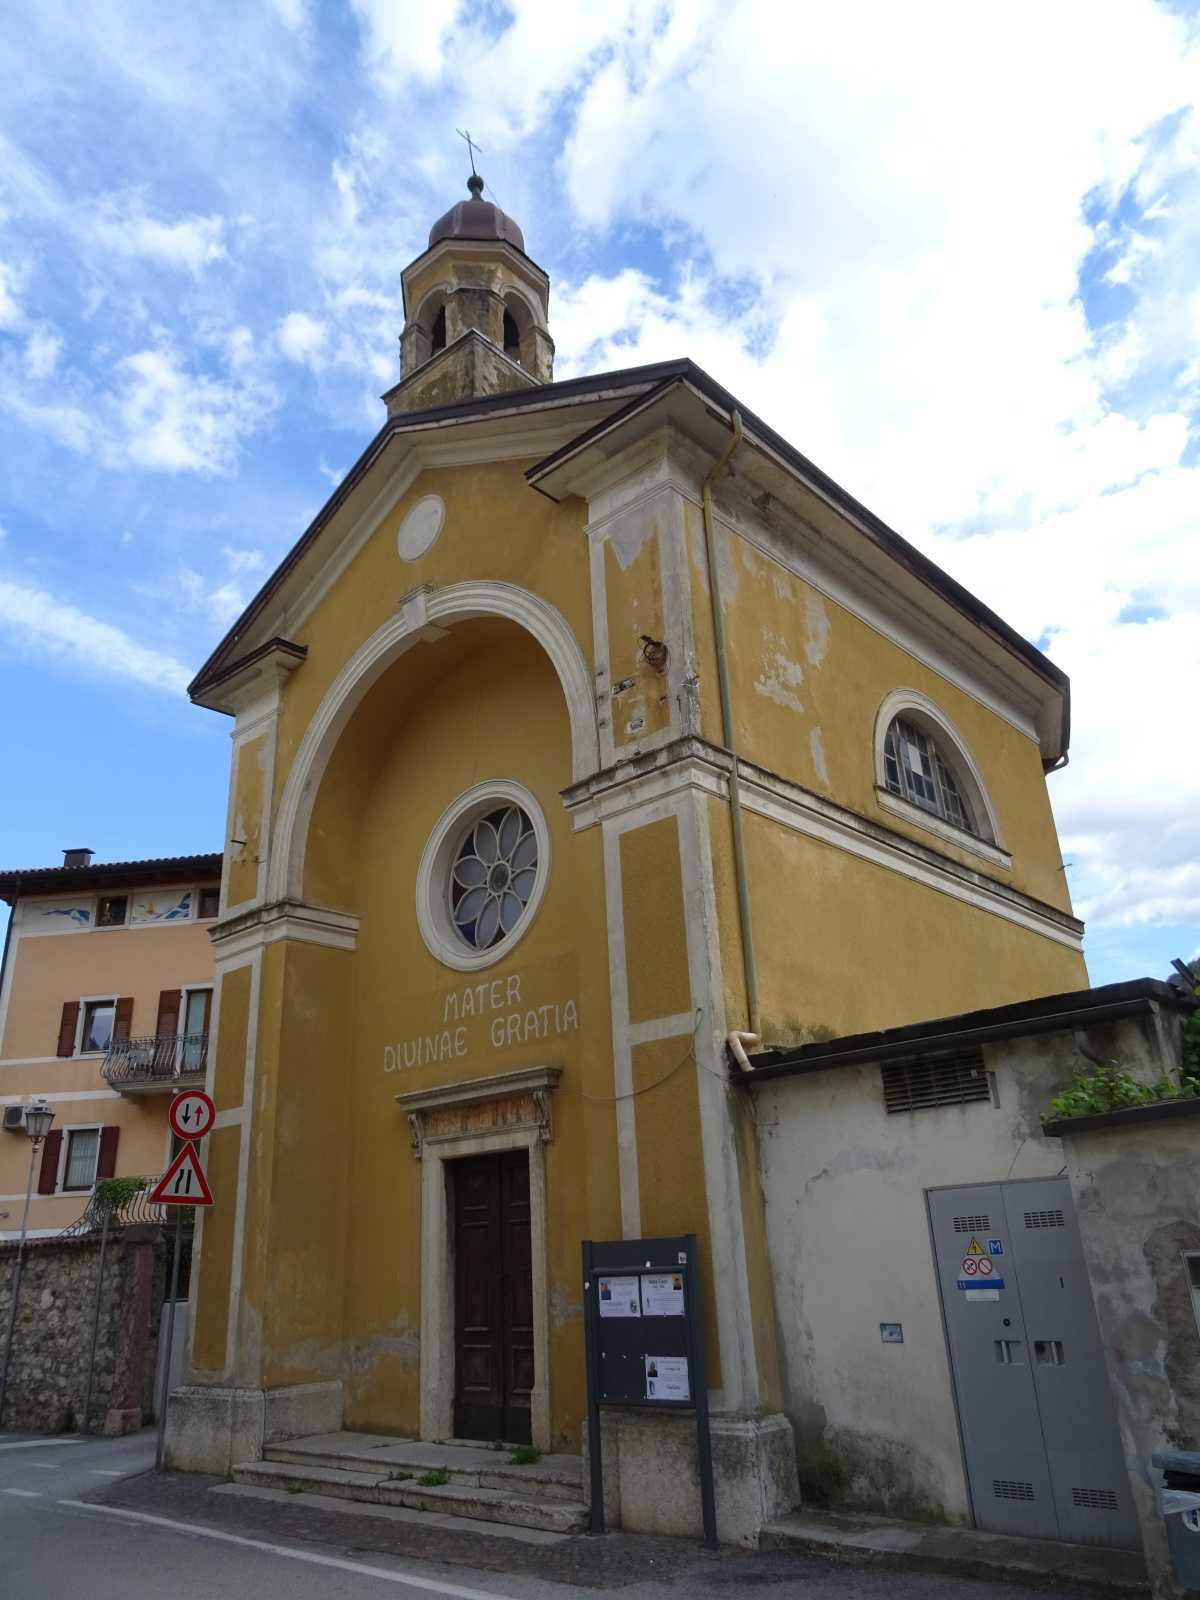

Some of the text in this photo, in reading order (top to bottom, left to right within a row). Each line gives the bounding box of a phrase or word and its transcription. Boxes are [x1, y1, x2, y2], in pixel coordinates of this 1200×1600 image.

[444, 974, 521, 1022] MATER
[491, 1000, 578, 1047] GRATIA
[990, 1241, 1002, 1253] M
